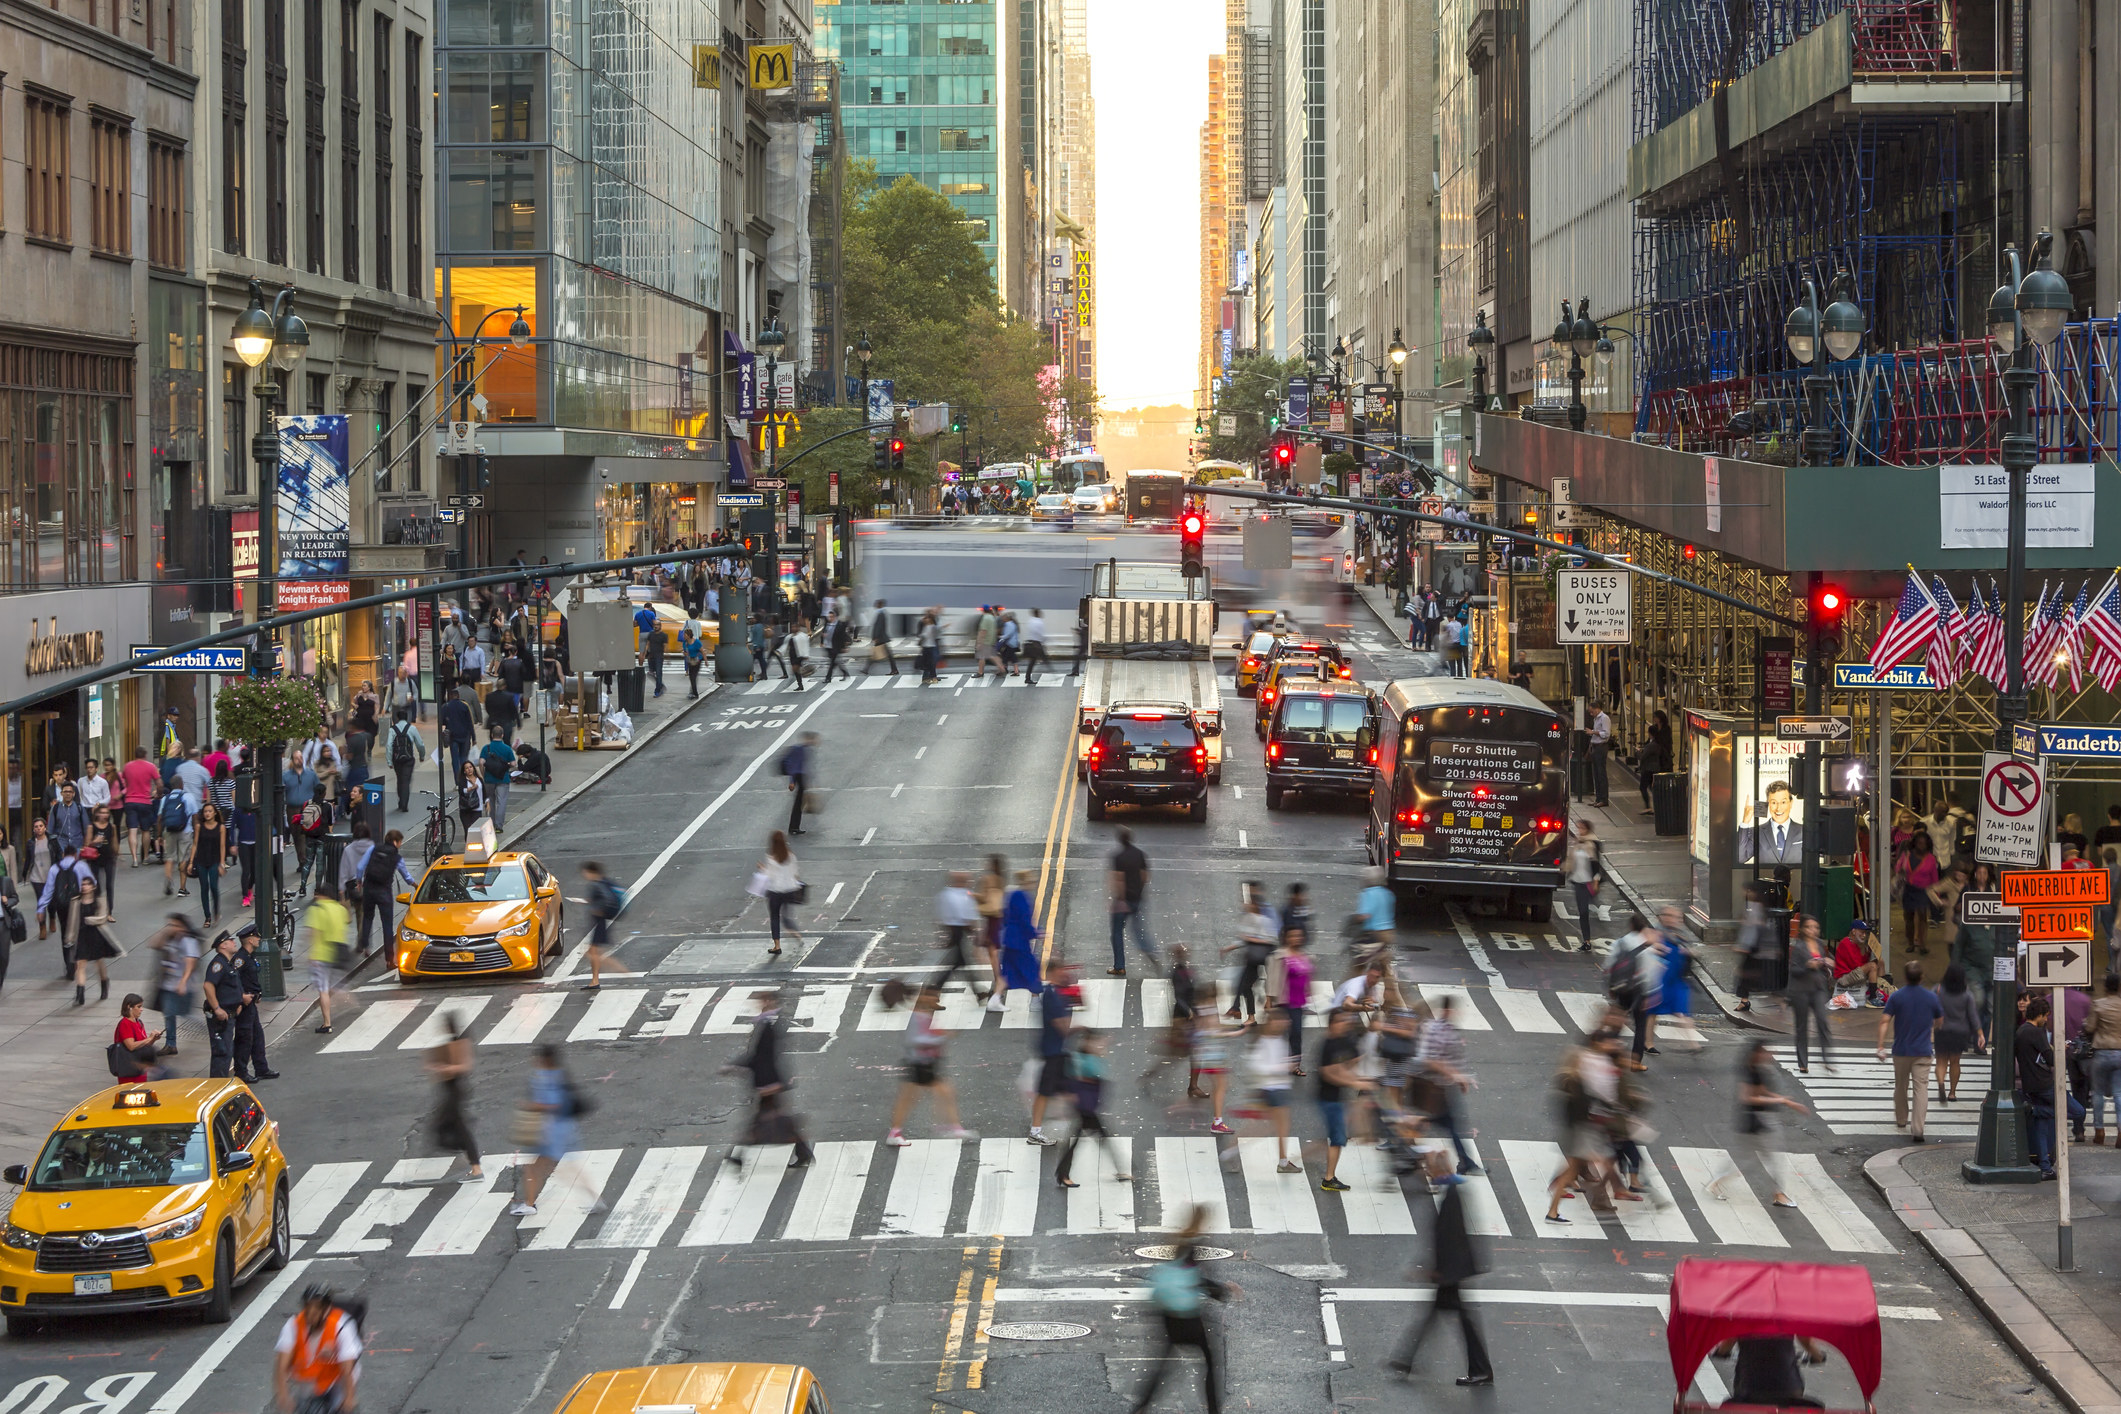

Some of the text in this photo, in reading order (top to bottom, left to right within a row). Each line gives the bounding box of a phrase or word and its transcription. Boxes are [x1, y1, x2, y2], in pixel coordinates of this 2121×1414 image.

[1077, 250, 1090, 326] MADAME
[741, 364, 751, 408] NAILS
[1974, 476, 1985, 485] 51
[1988, 475, 2006, 485] East
[2033, 474, 2060, 484] Street
[719, 496, 747, 504] Madison
[1979, 501, 2009, 509] Waldorf
[1571, 577, 1617, 588] BUSES
[279, 585, 348, 593] Newmark Grubb
[279, 595, 334, 606] Knight Frank
[1576, 593, 1611, 604] ONLY
[214, 653, 242, 666] Ave
[1838, 669, 1913, 684] Vandrbilt
[720, 704, 799, 715] BUS
[679, 719, 786, 733] ONLY
[1783, 724, 1843, 733] ONE WAY
[2014, 732, 2022, 751] East
[1452, 744, 1517, 756] For Shuttle
[1780, 742, 1805, 754] SHO
[1433, 756, 1535, 770] Reservations Call
[1446, 769, 1521, 781] 201.945.0556
[1442, 790, 1518, 801] SilverTowers.com
[1456, 810, 1501, 818] 212.473.4242
[1985, 820, 2035, 832] 7AM-10AM
[1435, 827, 1521, 838] RiverPlaceNYC.com
[1986, 834, 2031, 845] 4PM-7PM
[1980, 846, 2036, 859] MON THRU FRI
[2007, 876, 2104, 897] VANDERBILT AVE.
[1971, 902, 2001, 914] ONE
[2027, 912, 2089, 933] DETOUR
